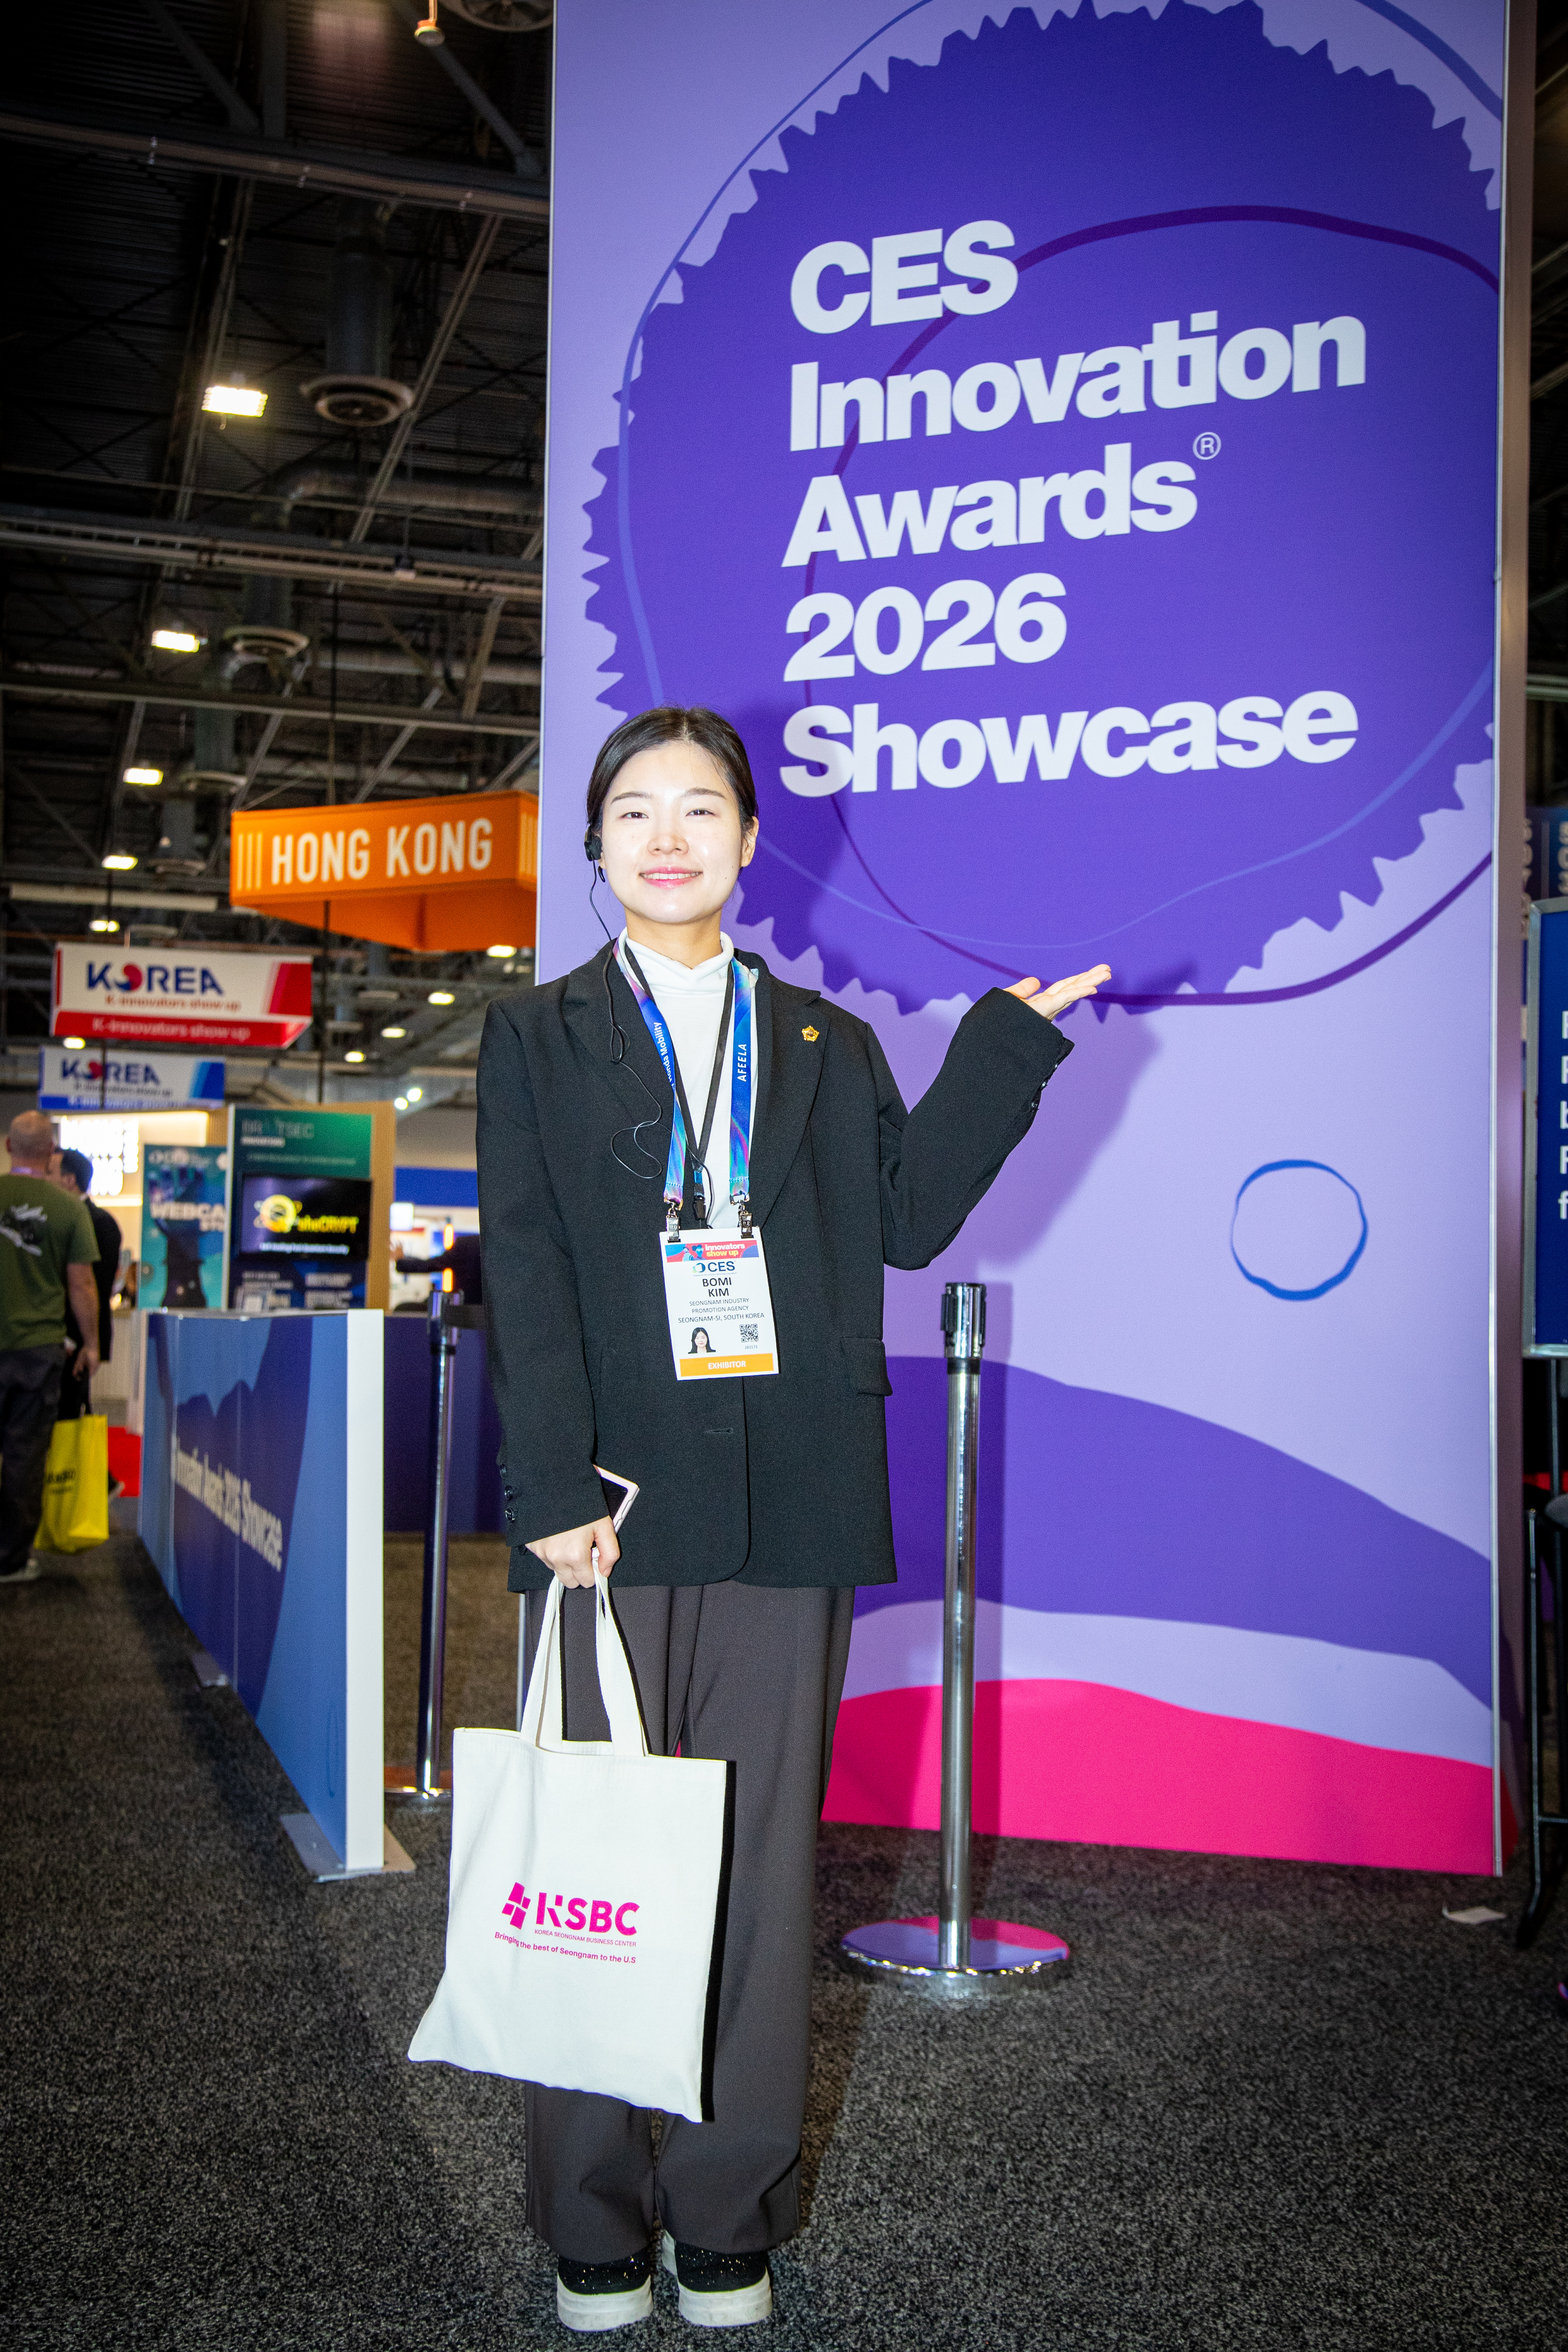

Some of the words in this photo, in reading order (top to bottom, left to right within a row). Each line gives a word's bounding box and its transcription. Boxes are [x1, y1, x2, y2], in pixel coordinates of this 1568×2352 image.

[790, 220, 1019, 334] CES
[790, 310, 1366, 452] Innovation
[783, 572, 1068, 682] 2026
[780, 690, 1359, 797] Showcase
[272, 828, 370, 885] HONG
[387, 818, 493, 878] KONG
[87, 961, 224, 996] KOREA
[654, 1022, 668, 1056] Mobility
[61, 1058, 161, 1086] KOREA
[737, 1044, 747, 1082] AFEELA
[702, 1277, 732, 1287] BOMI
[707, 1261, 735, 1272] CES
[708, 1288, 729, 1297] KIM
[678, 1315, 723, 1323] SEONGNAM-SI,
[708, 1360, 746, 1370] EXHIBITOR
[536, 1892, 640, 1936] KSBC
[494, 1932, 520, 1947] Bringing
[520, 1942, 531, 1950] the
[533, 1943, 549, 1951] best
[560, 1948, 598, 1960] Seongnam
[554, 1932, 585, 1942] SEONGNAM
[586, 1937, 614, 1945] BUSINESS
